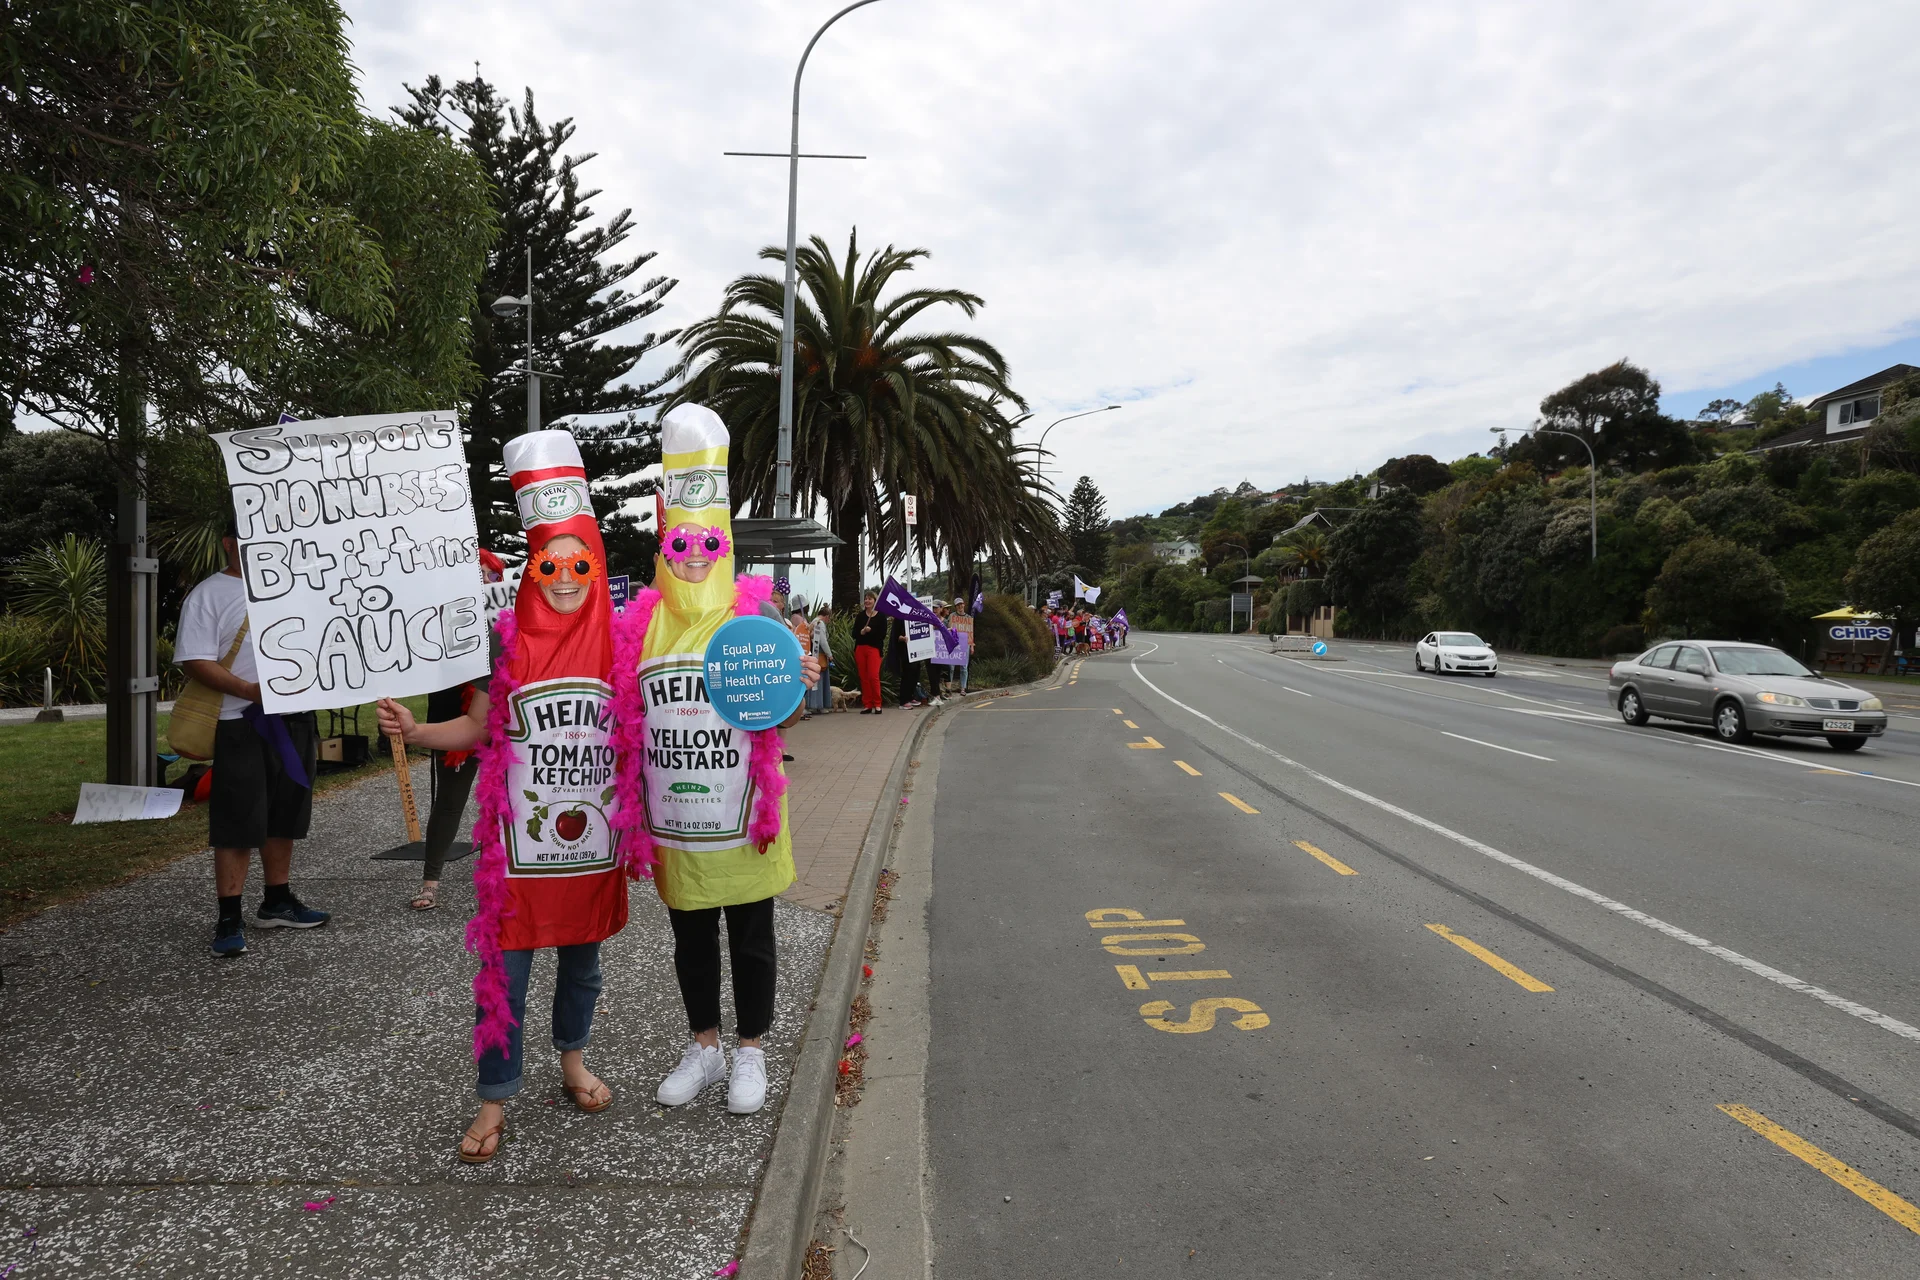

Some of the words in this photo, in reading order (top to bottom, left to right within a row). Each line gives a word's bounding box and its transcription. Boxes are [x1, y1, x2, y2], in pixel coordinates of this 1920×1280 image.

[229, 414, 454, 480] Support
[690, 475, 707, 483] HEINZ
[542, 486, 567, 498] HEINZ
[688, 483, 705, 495] 57
[547, 494, 567, 509] 57
[240, 538, 337, 602] B4
[343, 529, 391, 579] it
[390, 526, 478, 574] turns
[329, 578, 393, 616] to
[484, 585, 519, 611] QUA
[1830, 626, 1893, 640] CHIPS
[259, 596, 480, 695] SAUCE
[722, 643, 752, 657] Equal
[755, 642, 776, 656] pay
[723, 660, 739, 671] for
[742, 658, 786, 670] Primary
[725, 674, 761, 687] Health
[764, 672, 792, 685] Care
[649, 675, 710, 707] HEIN
[726, 689, 765, 703] nurses!
[534, 699, 609, 733] HEINZ
[676, 707, 699, 716] 1869
[564, 731, 587, 740] 1869
[650, 727, 732, 749] YELLOW
[528, 744, 615, 767] TOMATO
[647, 747, 739, 770] MUSTARD
[532, 767, 611, 786] KETCHUP
[404, 783, 417, 823] TALBOTS
[661, 794, 672, 803] 57
[673, 796, 722, 804] VARIETIES
[664, 819, 674, 827] NET
[675, 821, 682, 829] WT
[683, 821, 691, 829] 14
[692, 821, 700, 829] OZ
[701, 821, 721, 830] (397g)
[549, 828, 566, 849] GROWN
[567, 842, 580, 851] NOT
[536, 853, 549, 862] NET
[550, 852, 560, 861] WT
[561, 852, 569, 860] 14
[570, 851, 579, 860] OZ
[579, 850, 597, 860] (397g)
[1084, 907, 1271, 1034] STOP
